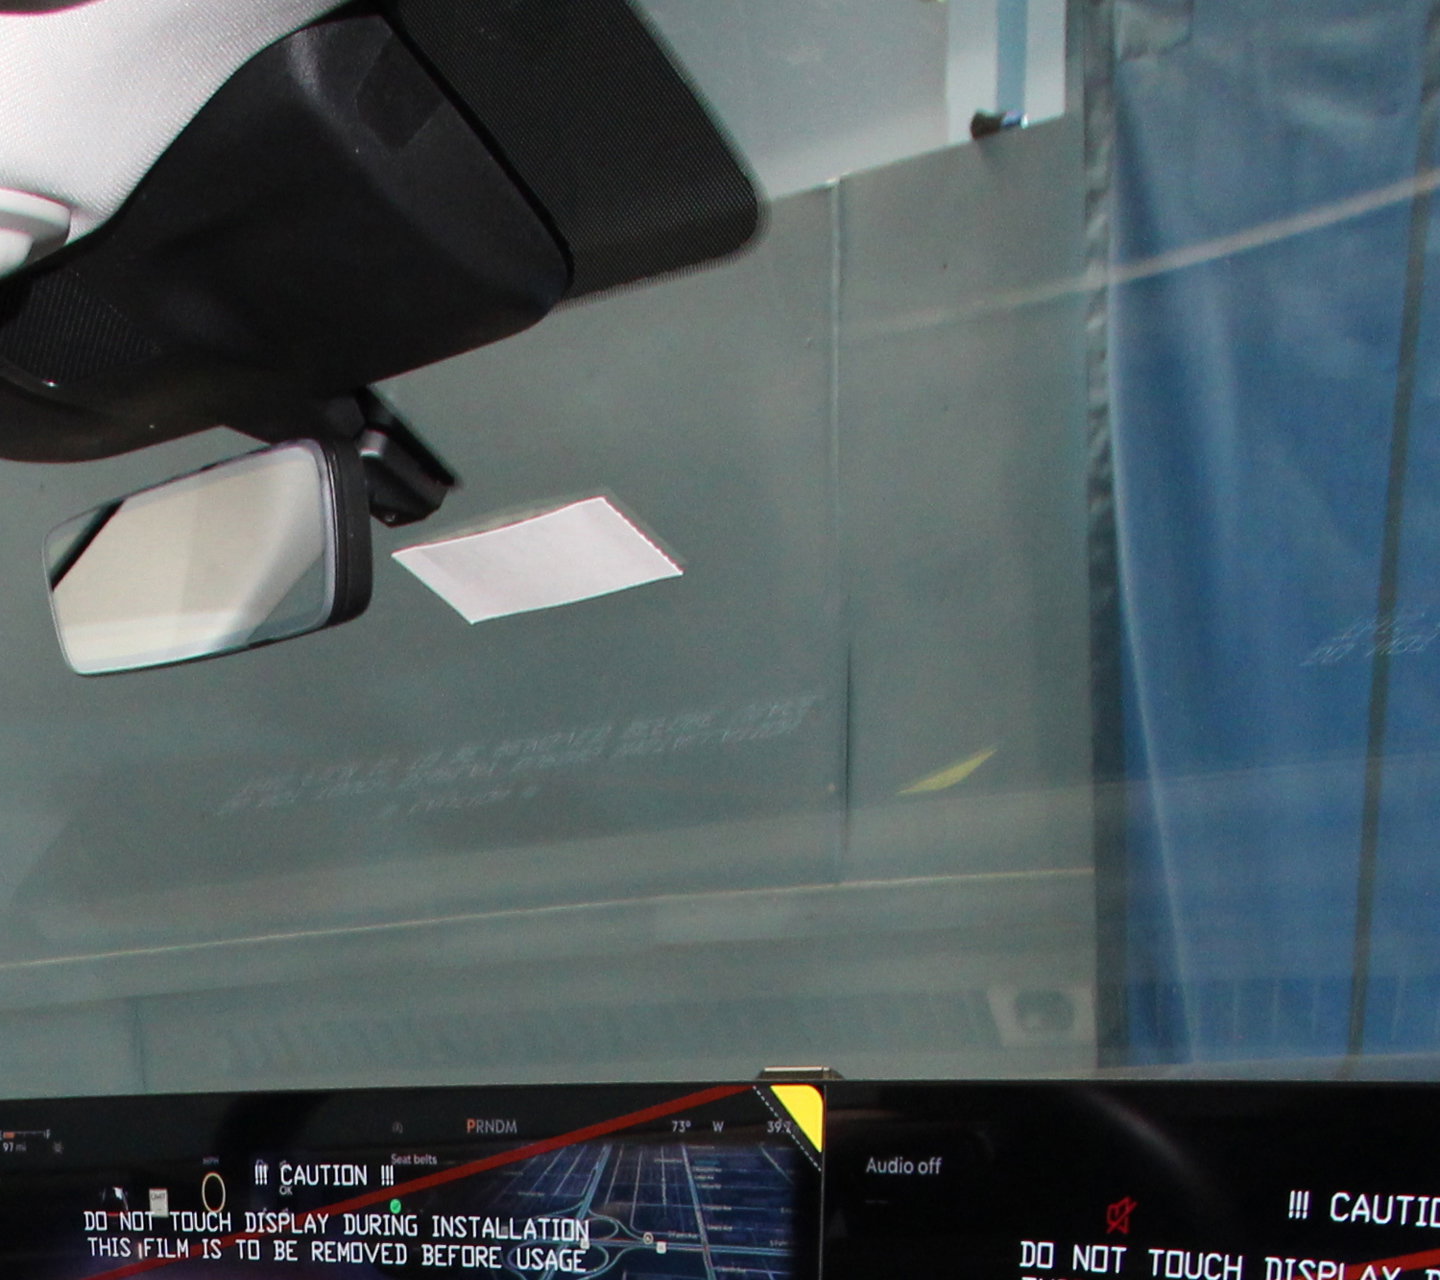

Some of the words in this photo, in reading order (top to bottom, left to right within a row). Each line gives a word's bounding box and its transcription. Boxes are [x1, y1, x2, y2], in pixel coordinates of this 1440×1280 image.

[712, 1121, 724, 1133] W
[2, 1142, 15, 1152] 97
[391, 1153, 411, 1166] Seat
[413, 1154, 438, 1166] belts
[865, 1156, 914, 1174] Audio
[917, 1156, 942, 1175] off
[280, 1164, 368, 1187] CAUTION
[381, 1164, 395, 1187] !!!
[1288, 1190, 1310, 1220] !!!
[84, 1210, 108, 1232] DO
[120, 1211, 156, 1232] NOT
[170, 1211, 233, 1233] TOUCH
[244, 1212, 329, 1235] DISPLAY
[344, 1213, 418, 1237] DURING
[432, 1215, 590, 1242] INSTALLATION
[87, 1236, 132, 1257] THIS
[142, 1237, 189, 1259] FILM
[202, 1238, 222, 1259] IS
[235, 1239, 261, 1260] TO
[273, 1240, 298, 1262] BE
[311, 1240, 408, 1265] REMOVED
[421, 1244, 502, 1269] BEFORE
[516, 1248, 587, 1273] USAGE
[1019, 1241, 1054, 1269] DO
[1072, 1244, 1127, 1274] NOT
